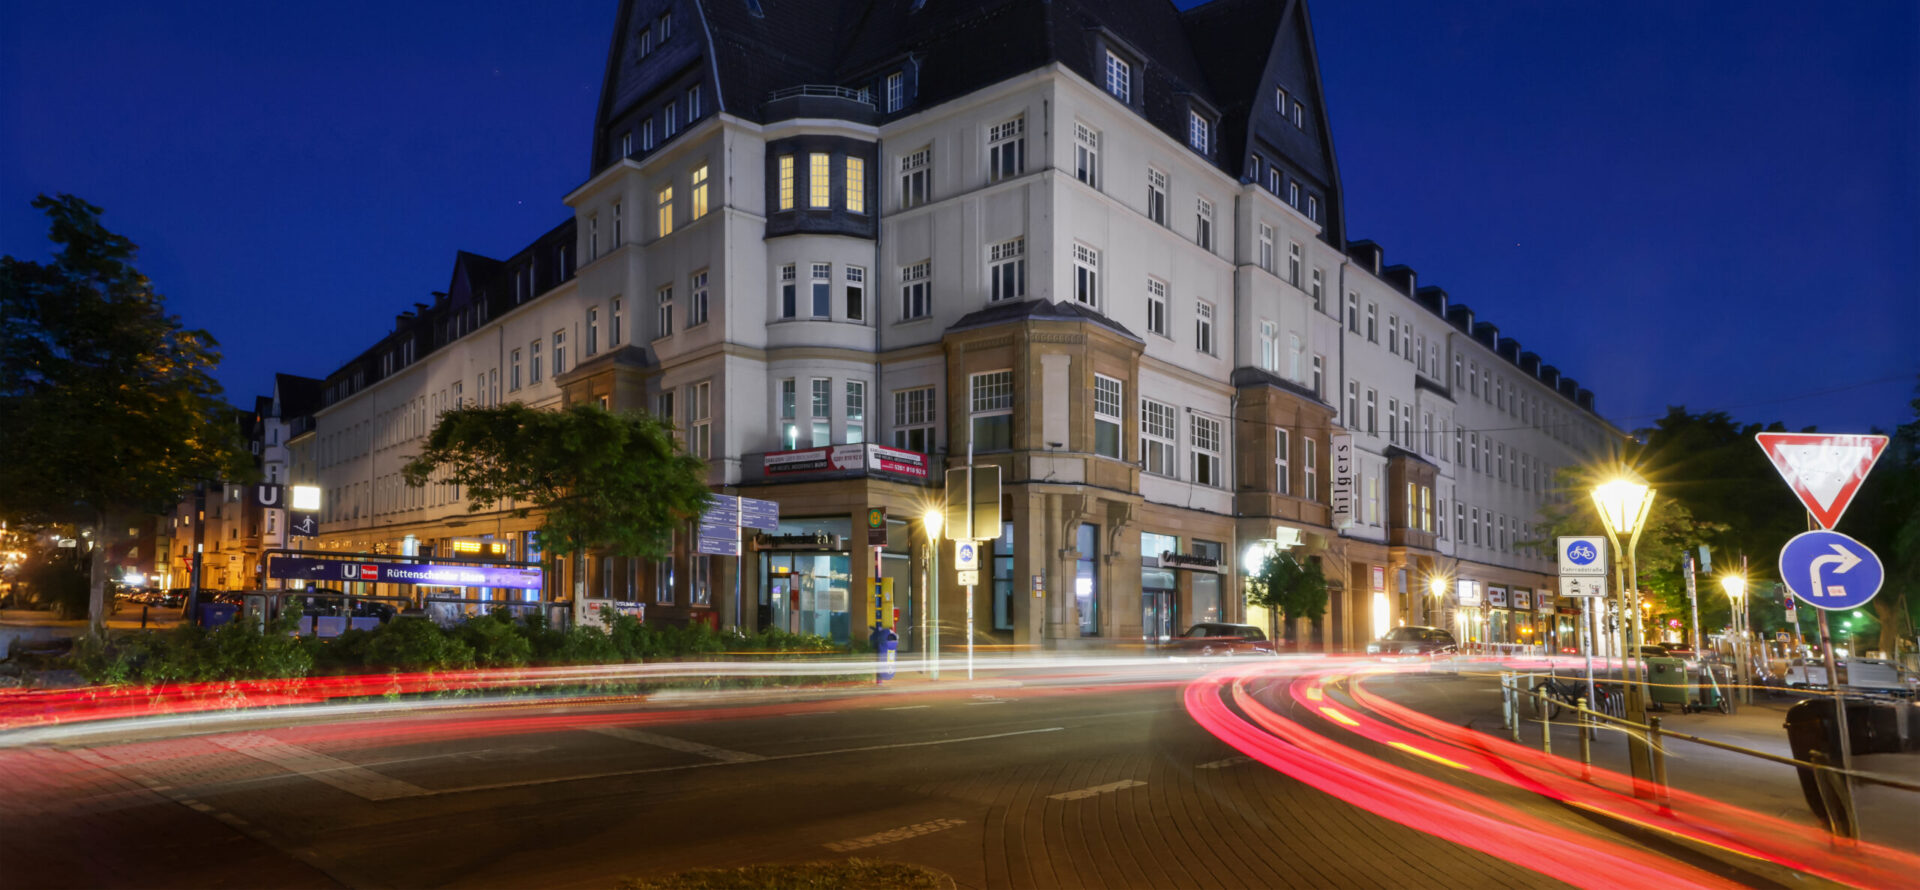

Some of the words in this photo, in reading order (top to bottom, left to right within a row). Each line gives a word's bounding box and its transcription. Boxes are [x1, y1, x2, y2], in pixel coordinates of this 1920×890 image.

[1334, 444, 1352, 515] hilgers
[259, 485, 277, 505] U
[344, 564, 357, 578] U
